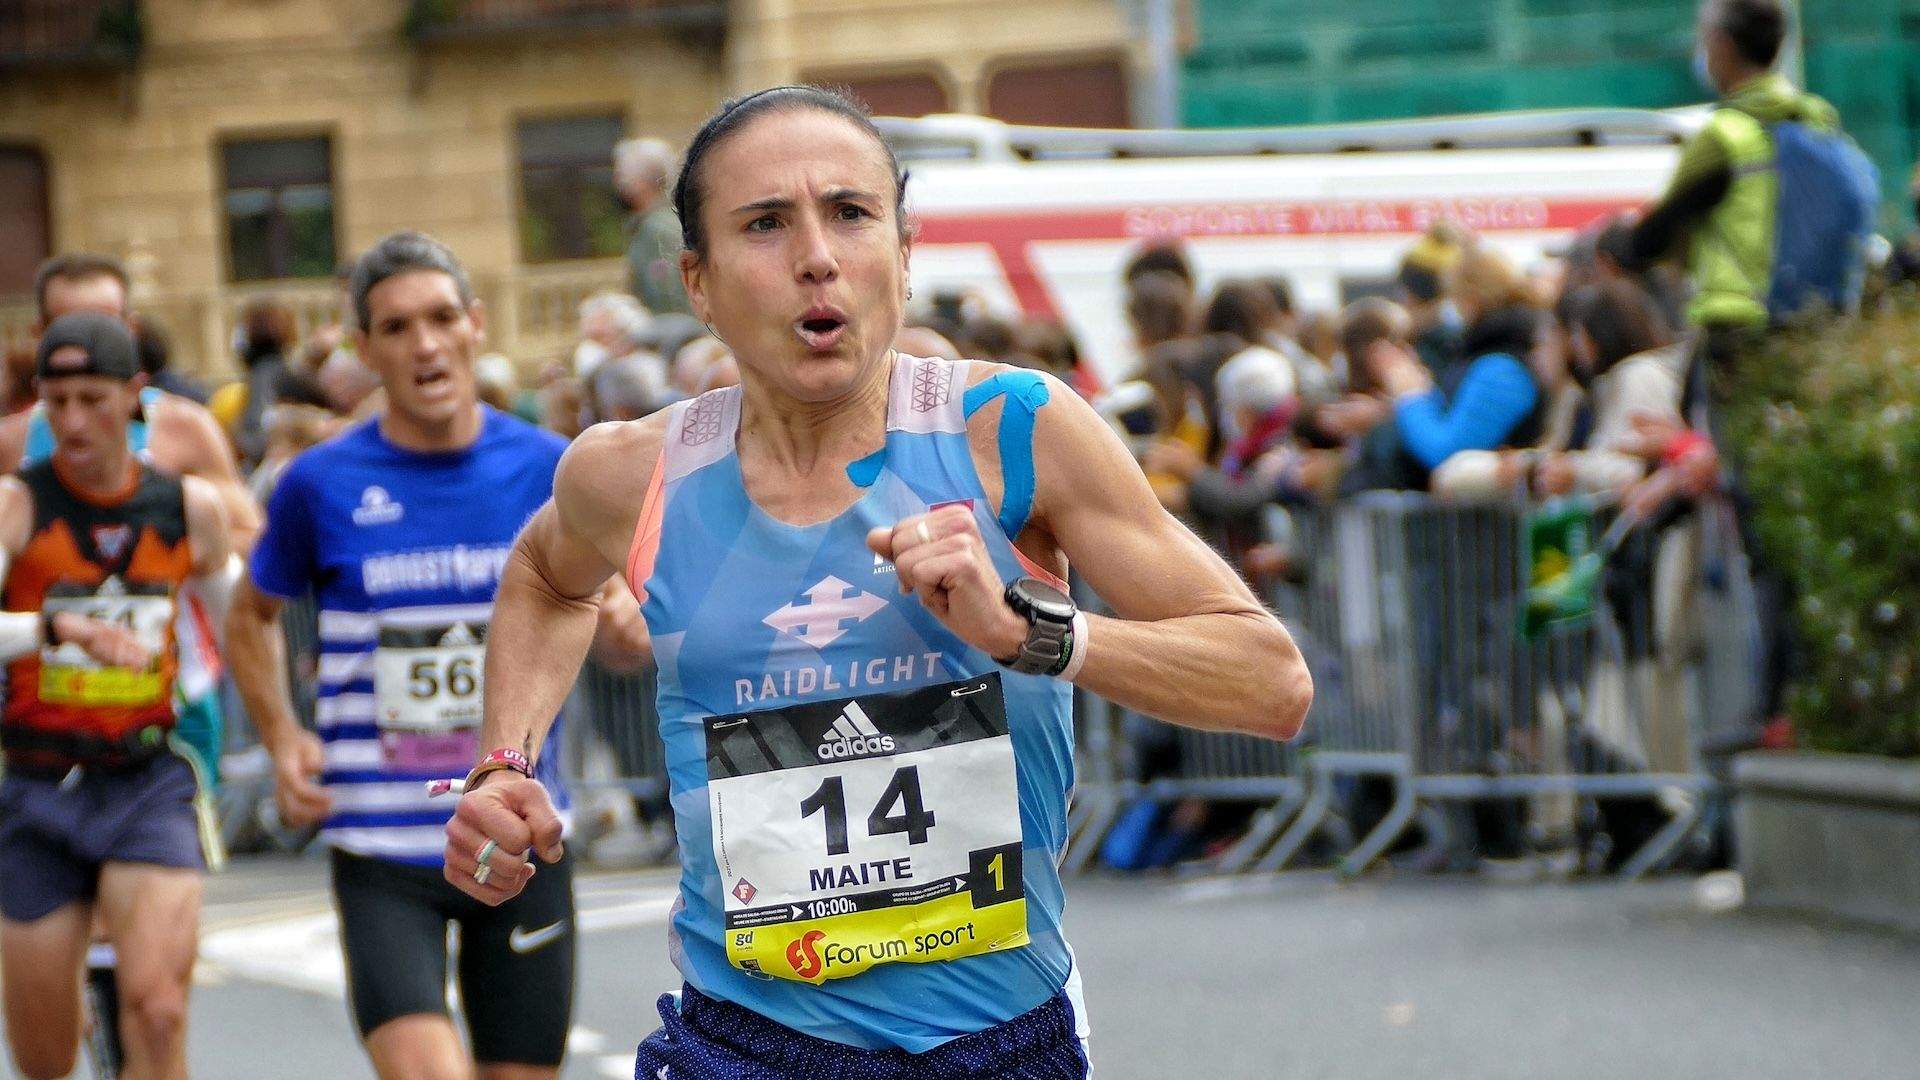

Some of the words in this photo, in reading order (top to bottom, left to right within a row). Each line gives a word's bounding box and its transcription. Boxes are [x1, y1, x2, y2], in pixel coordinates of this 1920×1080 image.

[735, 652, 942, 705] RAIDLIGHT
[817, 735, 896, 759] adidas
[800, 765, 936, 856] 14
[809, 857, 913, 891] MAITE
[987, 853, 1005, 892] 1
[807, 897, 857, 919] 10:00h
[914, 922, 975, 955] sport
